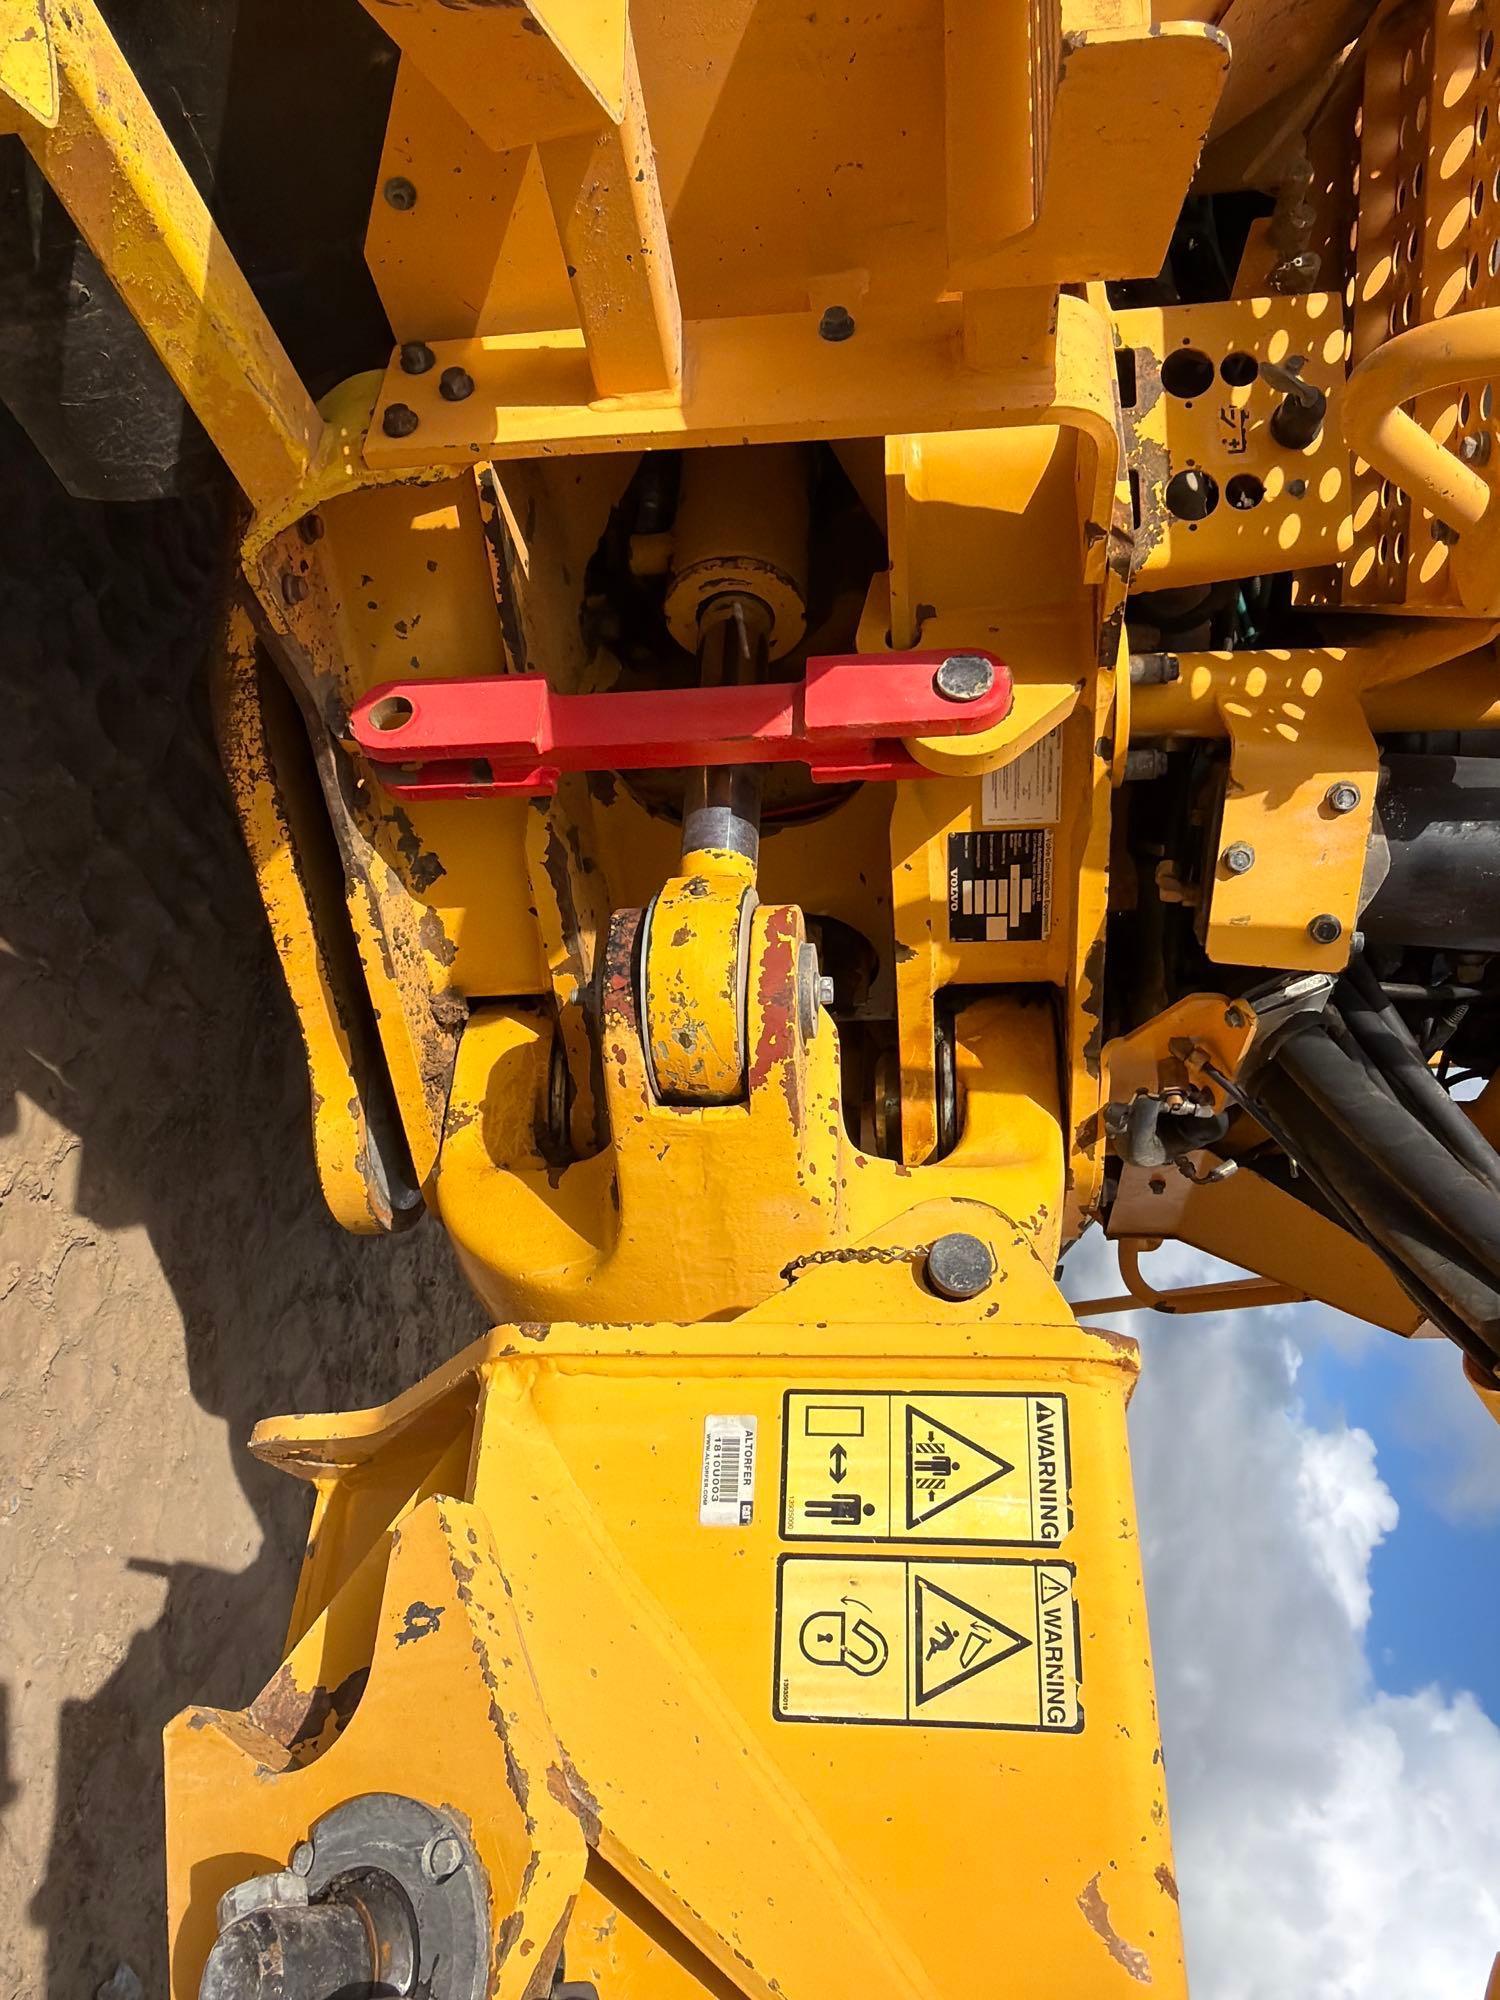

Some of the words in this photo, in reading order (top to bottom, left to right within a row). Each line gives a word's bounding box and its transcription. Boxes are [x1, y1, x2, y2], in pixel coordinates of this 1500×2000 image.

[950, 867, 959, 912] VOLVO
[1044, 858, 1052, 898] Construction
[703, 1433, 711, 1506] WWW.ALTORFER.COM
[712, 1437, 722, 1502] 1810U003
[744, 1430, 753, 1486] ALTORFER
[1037, 1423, 1059, 1540] WARNING
[1044, 1608, 1066, 1724] WARNING
